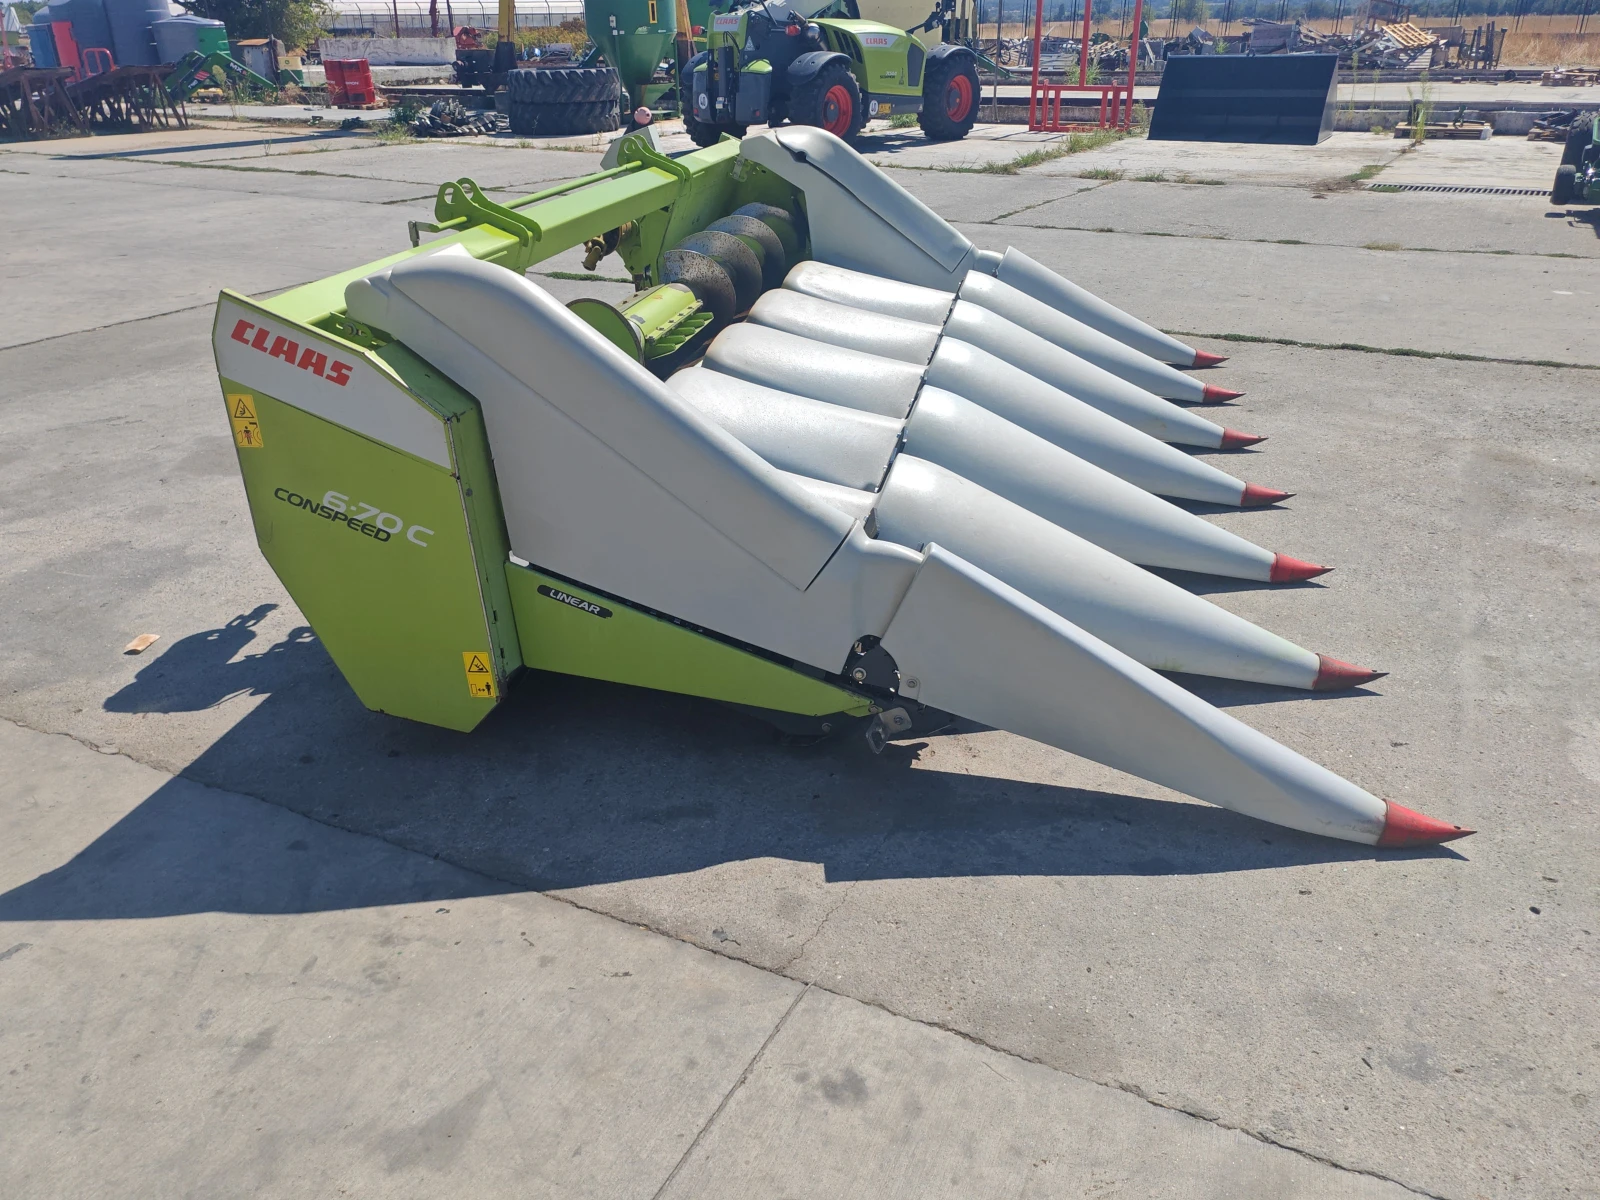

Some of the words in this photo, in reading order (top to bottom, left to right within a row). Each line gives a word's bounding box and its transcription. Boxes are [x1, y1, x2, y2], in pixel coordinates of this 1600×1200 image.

[865, 37, 888, 45] CLAAS
[231, 319, 353, 387] CLAAS
[274, 487, 391, 543] CONSPEED
[406, 525, 435, 548] C
[549, 589, 601, 615] LINEAR
